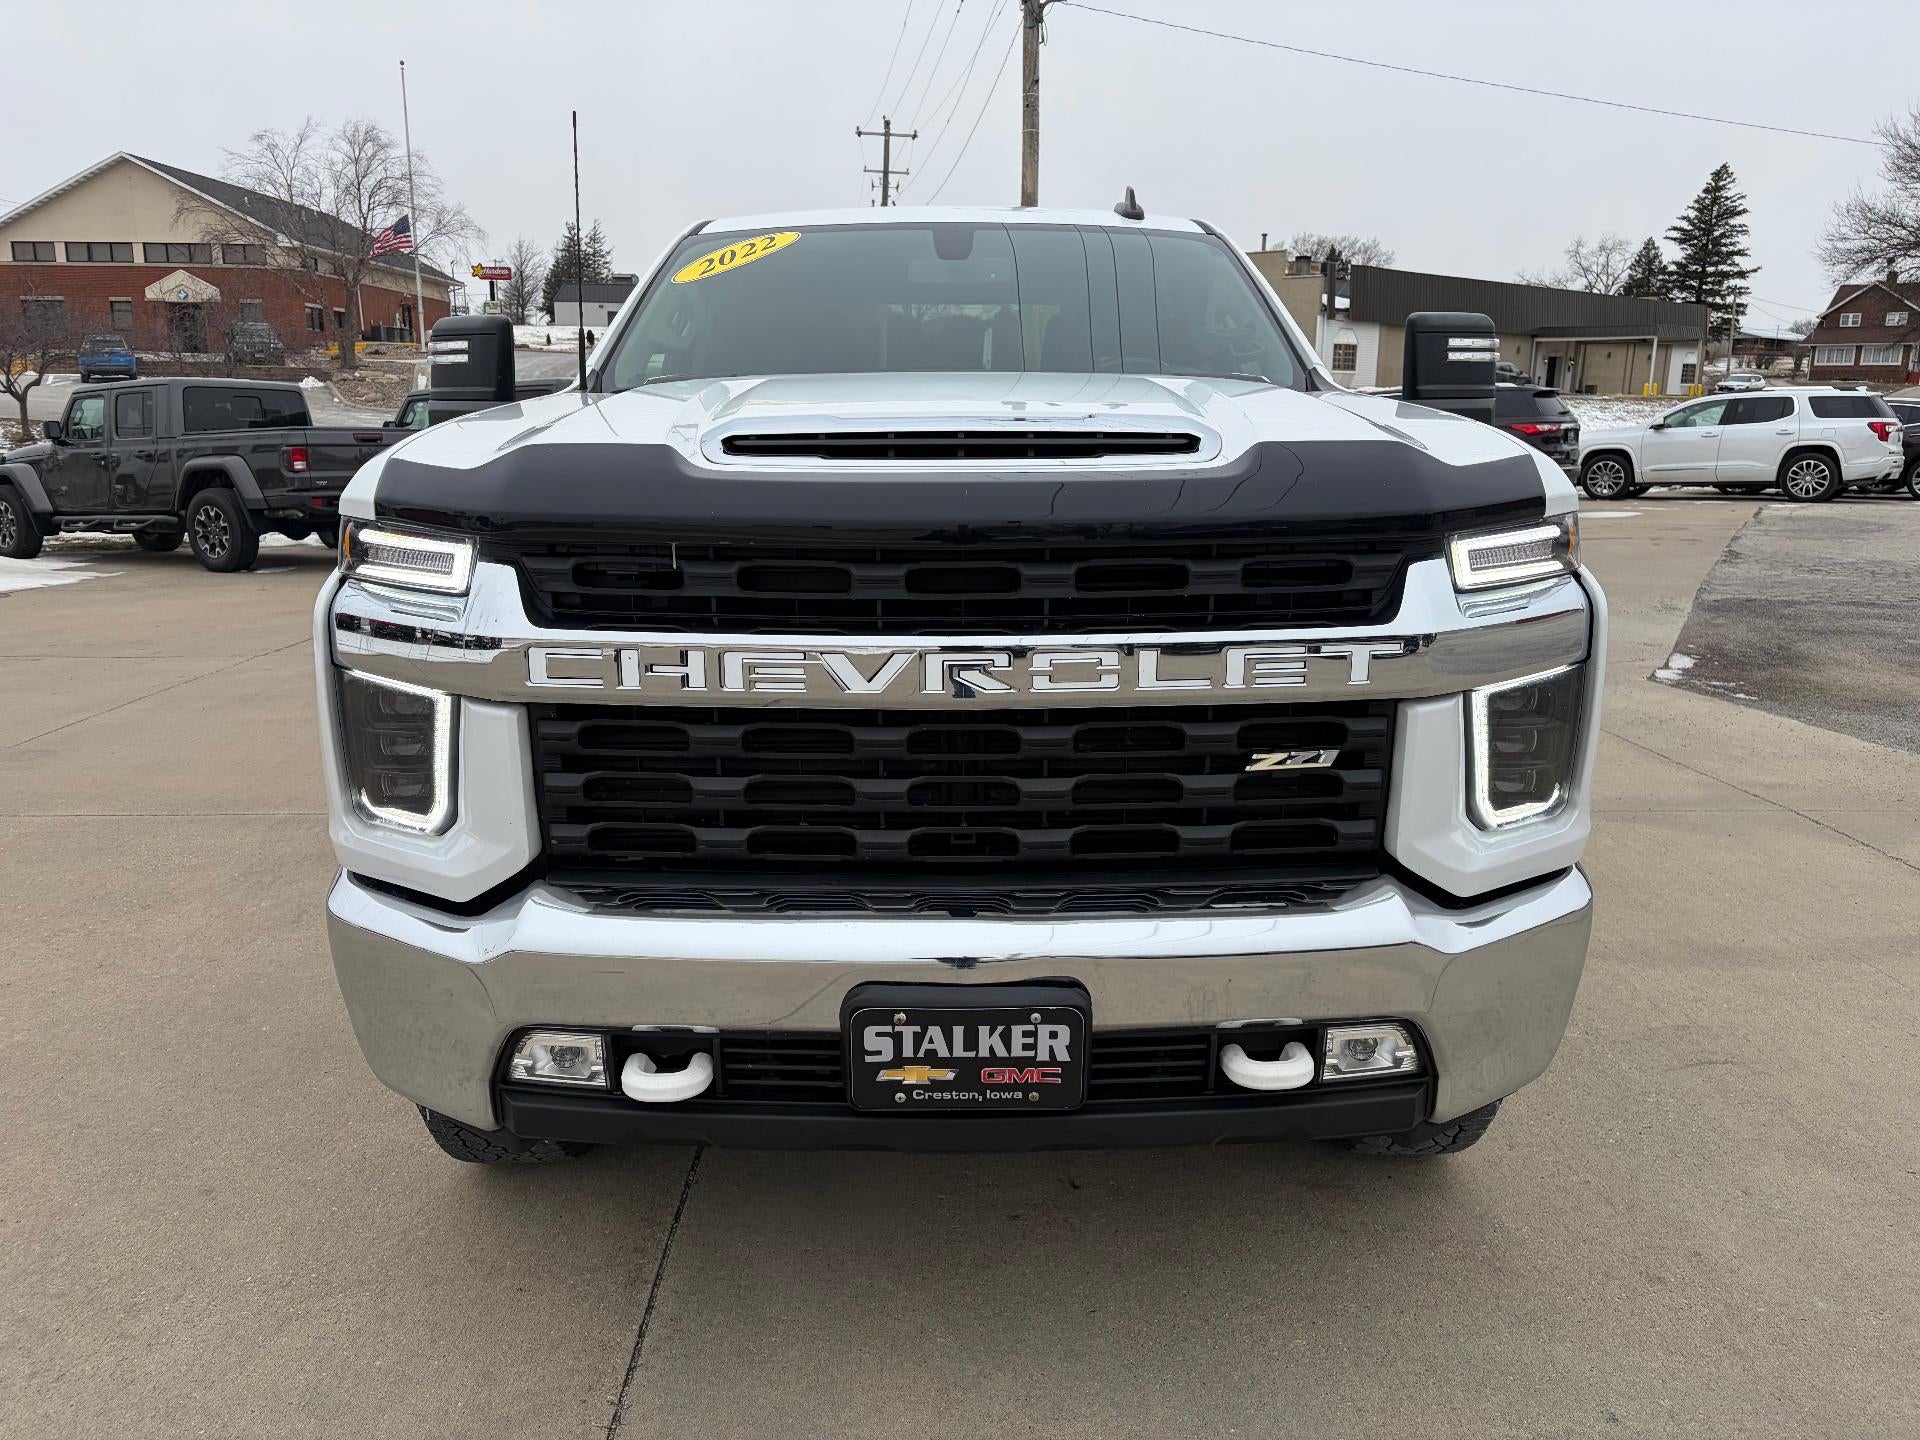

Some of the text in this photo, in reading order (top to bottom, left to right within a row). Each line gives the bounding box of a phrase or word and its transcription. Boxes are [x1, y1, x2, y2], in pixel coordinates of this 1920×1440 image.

[698, 235, 777, 276] 2022
[526, 644, 1374, 694] CHEVROLET
[1245, 750, 1339, 771] Z71
[864, 1025, 1071, 1063] STALKER
[981, 1067, 1061, 1084] GMC
[912, 1089, 1023, 1101] Creston, Iowa
